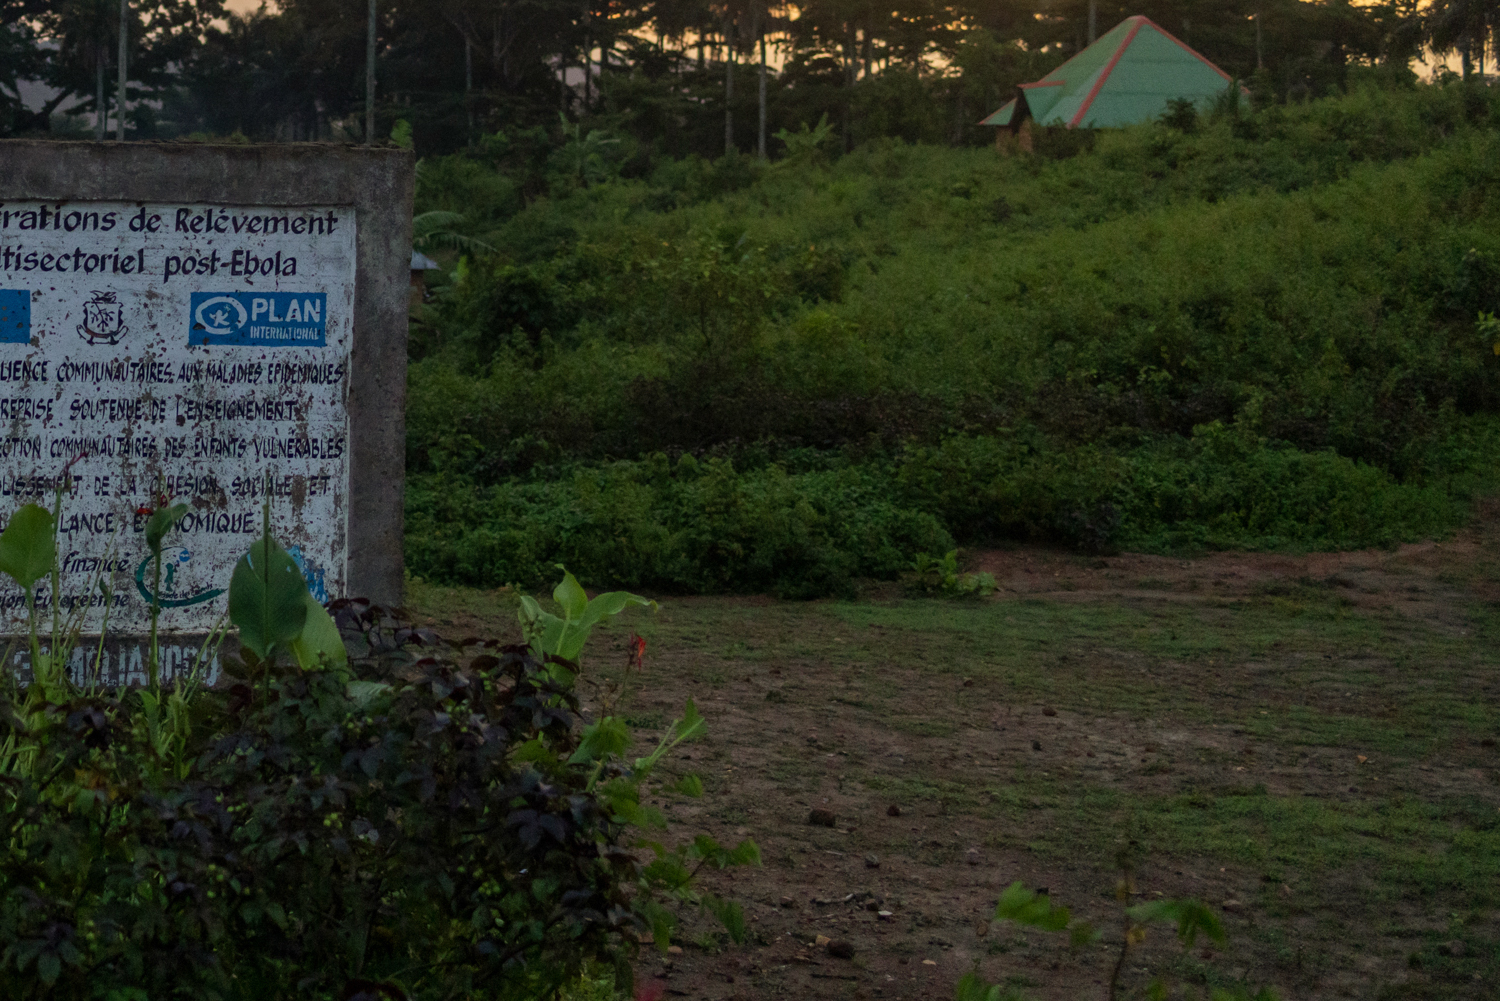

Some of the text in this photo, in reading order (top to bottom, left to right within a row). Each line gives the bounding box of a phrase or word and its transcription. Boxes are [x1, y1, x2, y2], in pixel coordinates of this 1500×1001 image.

[128, 206, 162, 233] de
[163, 249, 297, 284] post-Ebola
[251, 297, 321, 324] PLAN
[250, 325, 320, 341] INTERNATIONAL
[56, 361, 172, 384] COMMUNAUTAIRES
[176, 363, 201, 384] AUX
[206, 363, 263, 385] MALADIES
[268, 363, 344, 386] EPIDEMIQUES
[1, 399, 54, 420] REPRISE
[70, 399, 142, 421] SOUTENUE
[152, 400, 166, 421] DE
[50, 437, 156, 459] COMMUNAUTAIRES
[165, 438, 186, 459] DES
[194, 437, 247, 458] ENFANTS
[254, 438, 344, 459] VULNERABLES
[94, 476, 109, 496] DE
[120, 476, 136, 496] LA
[309, 475, 330, 496] ET
